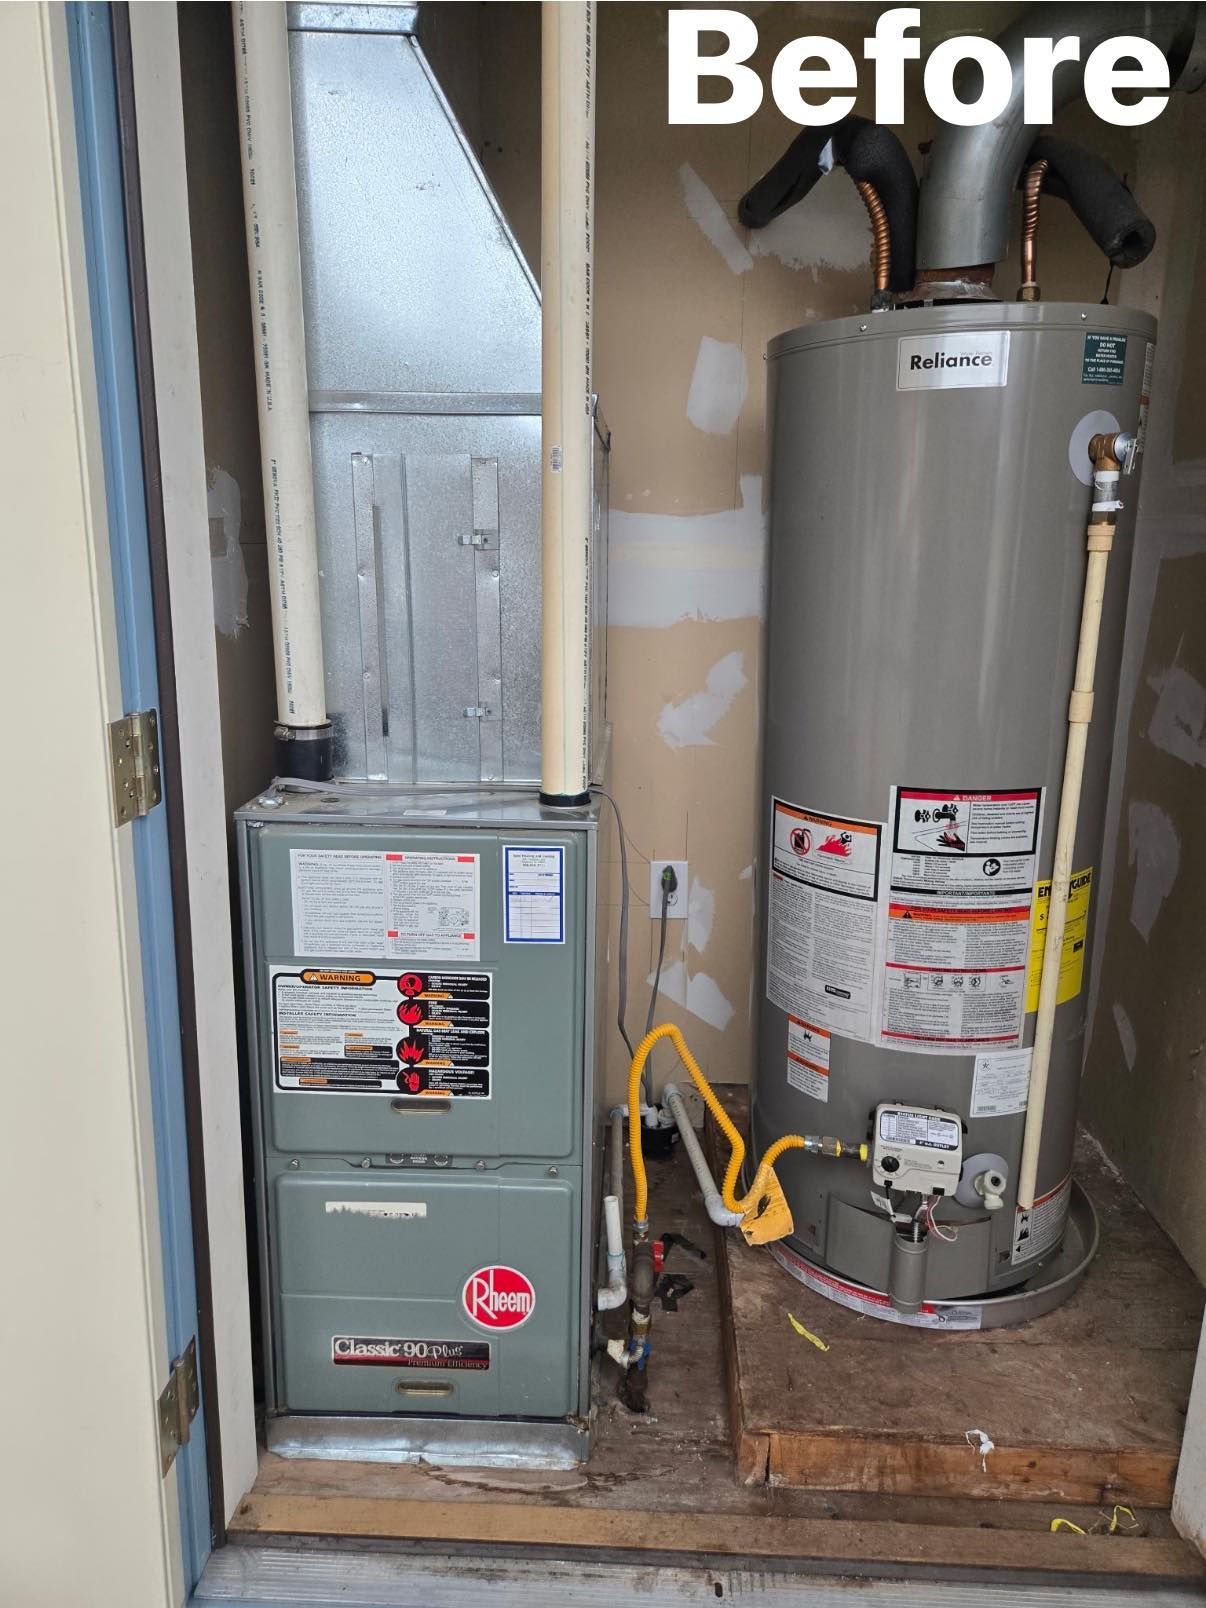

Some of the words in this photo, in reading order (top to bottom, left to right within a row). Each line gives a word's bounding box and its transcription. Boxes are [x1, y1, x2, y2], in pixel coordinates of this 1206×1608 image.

[910, 352, 992, 370] Reliance
[319, 974, 361, 982] WARNING
[472, 1269, 530, 1319] Rheem
[334, 1339, 400, 1357] Classic
[403, 1343, 427, 1357] 90
[427, 1344, 463, 1359] Plus
[408, 1359, 446, 1368] Premium
[447, 1360, 488, 1370] Efficiency
